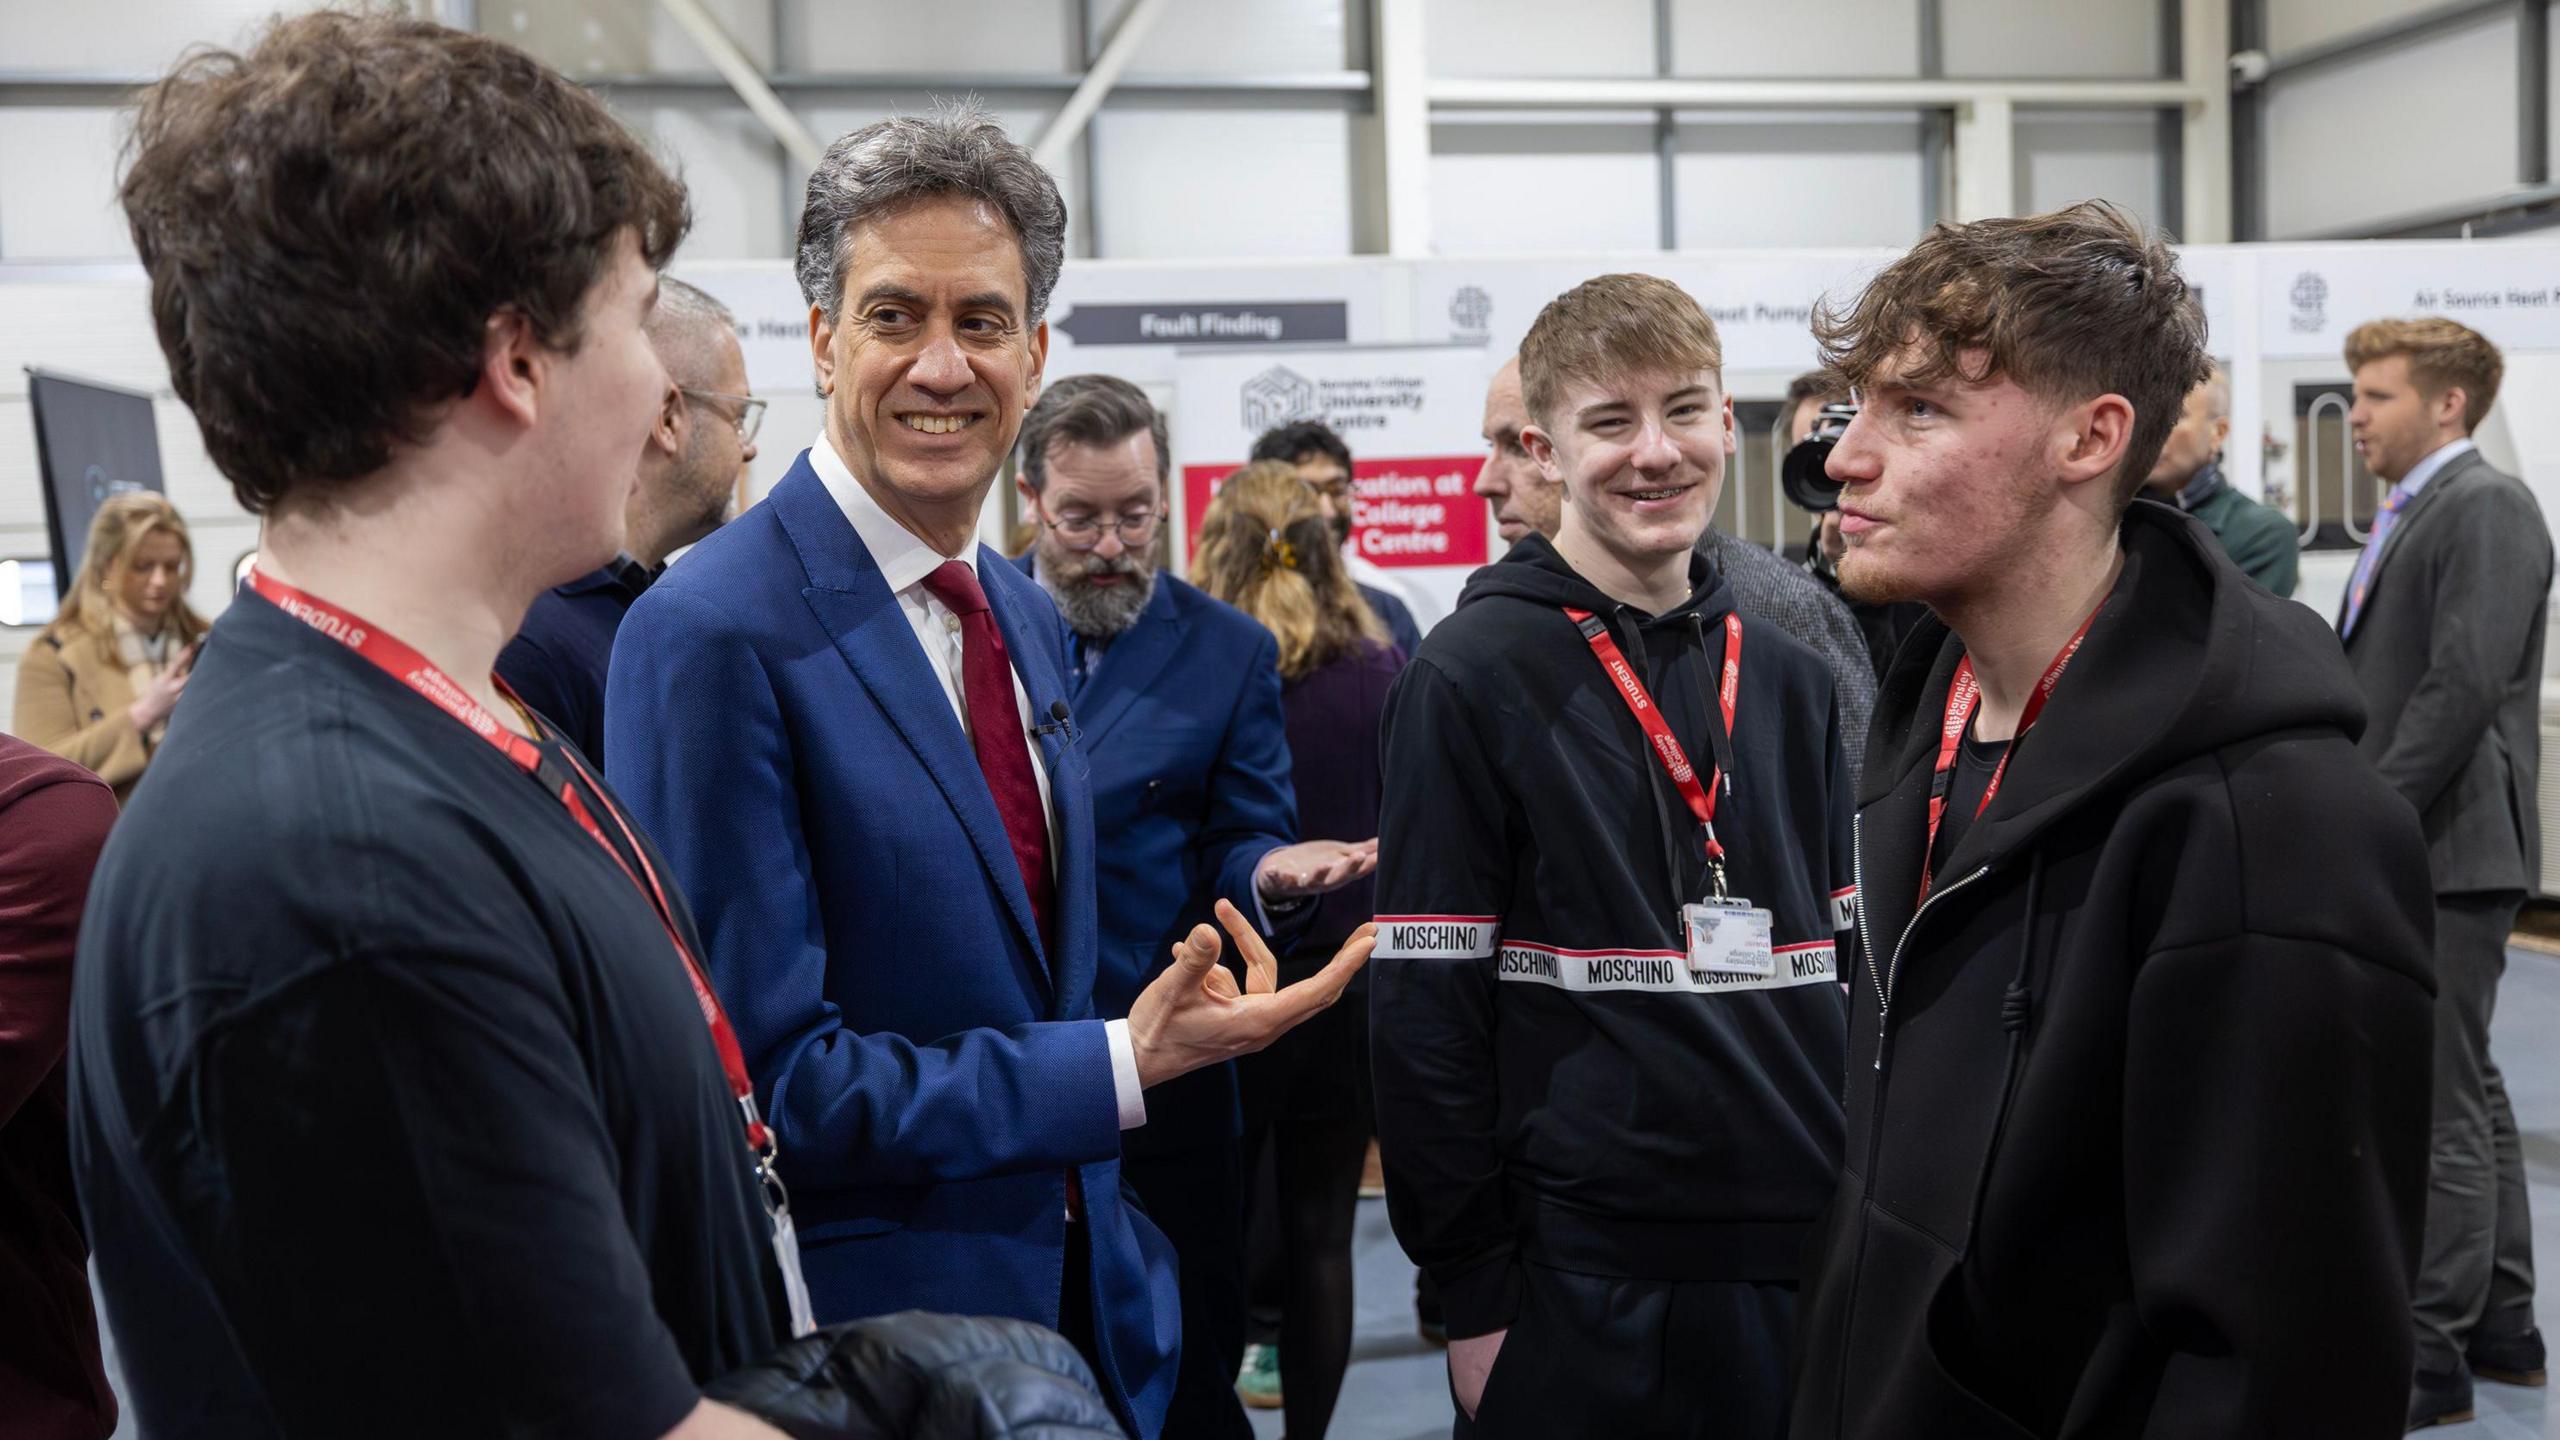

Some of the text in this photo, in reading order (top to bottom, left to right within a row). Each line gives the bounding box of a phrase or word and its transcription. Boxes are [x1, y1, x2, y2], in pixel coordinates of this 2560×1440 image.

[1140, 311, 1282, 340] Fault Finding
[1319, 393, 1422, 415] University
[1434, 471, 1464, 496] at
[1350, 498, 1446, 529] College
[1361, 527, 1450, 555] Centre
[1610, 659, 1648, 710] STUDENT
[1947, 671, 1973, 716] Barnsley
[1956, 680, 1979, 716] College
[1654, 734, 1676, 769] Barnsley
[1664, 735, 1684, 765] College
[1392, 926, 1477, 950] MOSCHINO
[1500, 949, 1558, 979] OSCHINO
[1588, 959, 1674, 985] MOSCHINO
